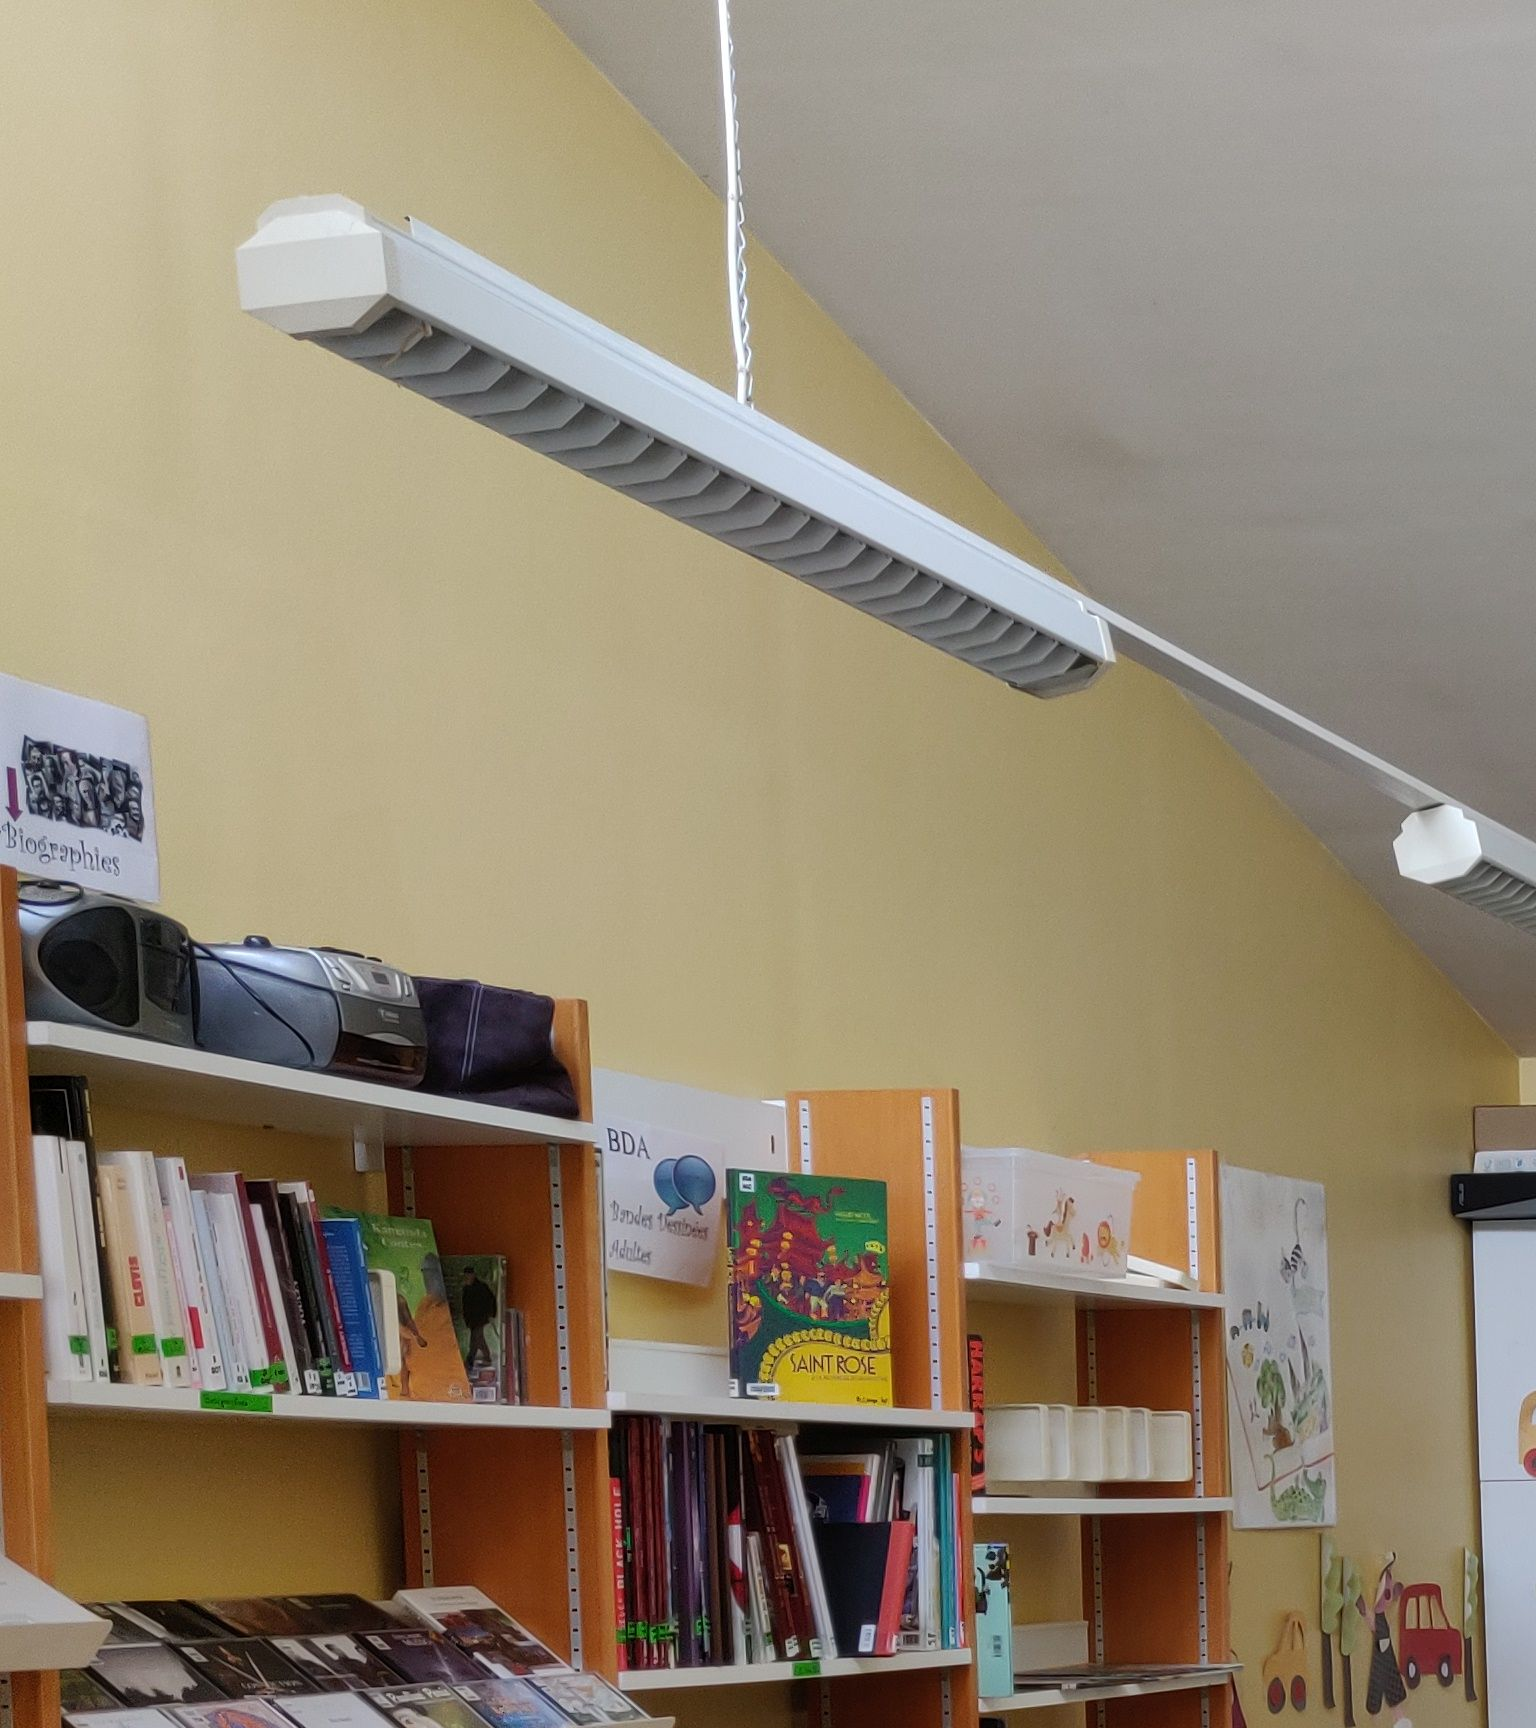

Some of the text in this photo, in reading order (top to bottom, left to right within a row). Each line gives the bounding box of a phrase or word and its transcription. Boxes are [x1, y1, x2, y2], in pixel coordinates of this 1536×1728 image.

[0, 821, 120, 876] Biographies
[606, 1127, 650, 1160] BDA
[608, 1200, 709, 1242] Bandes Dessinées
[608, 1240, 652, 1264] Adultes
[790, 1354, 876, 1375] SAINT ROSE
[614, 1539, 626, 1597] BLACK
